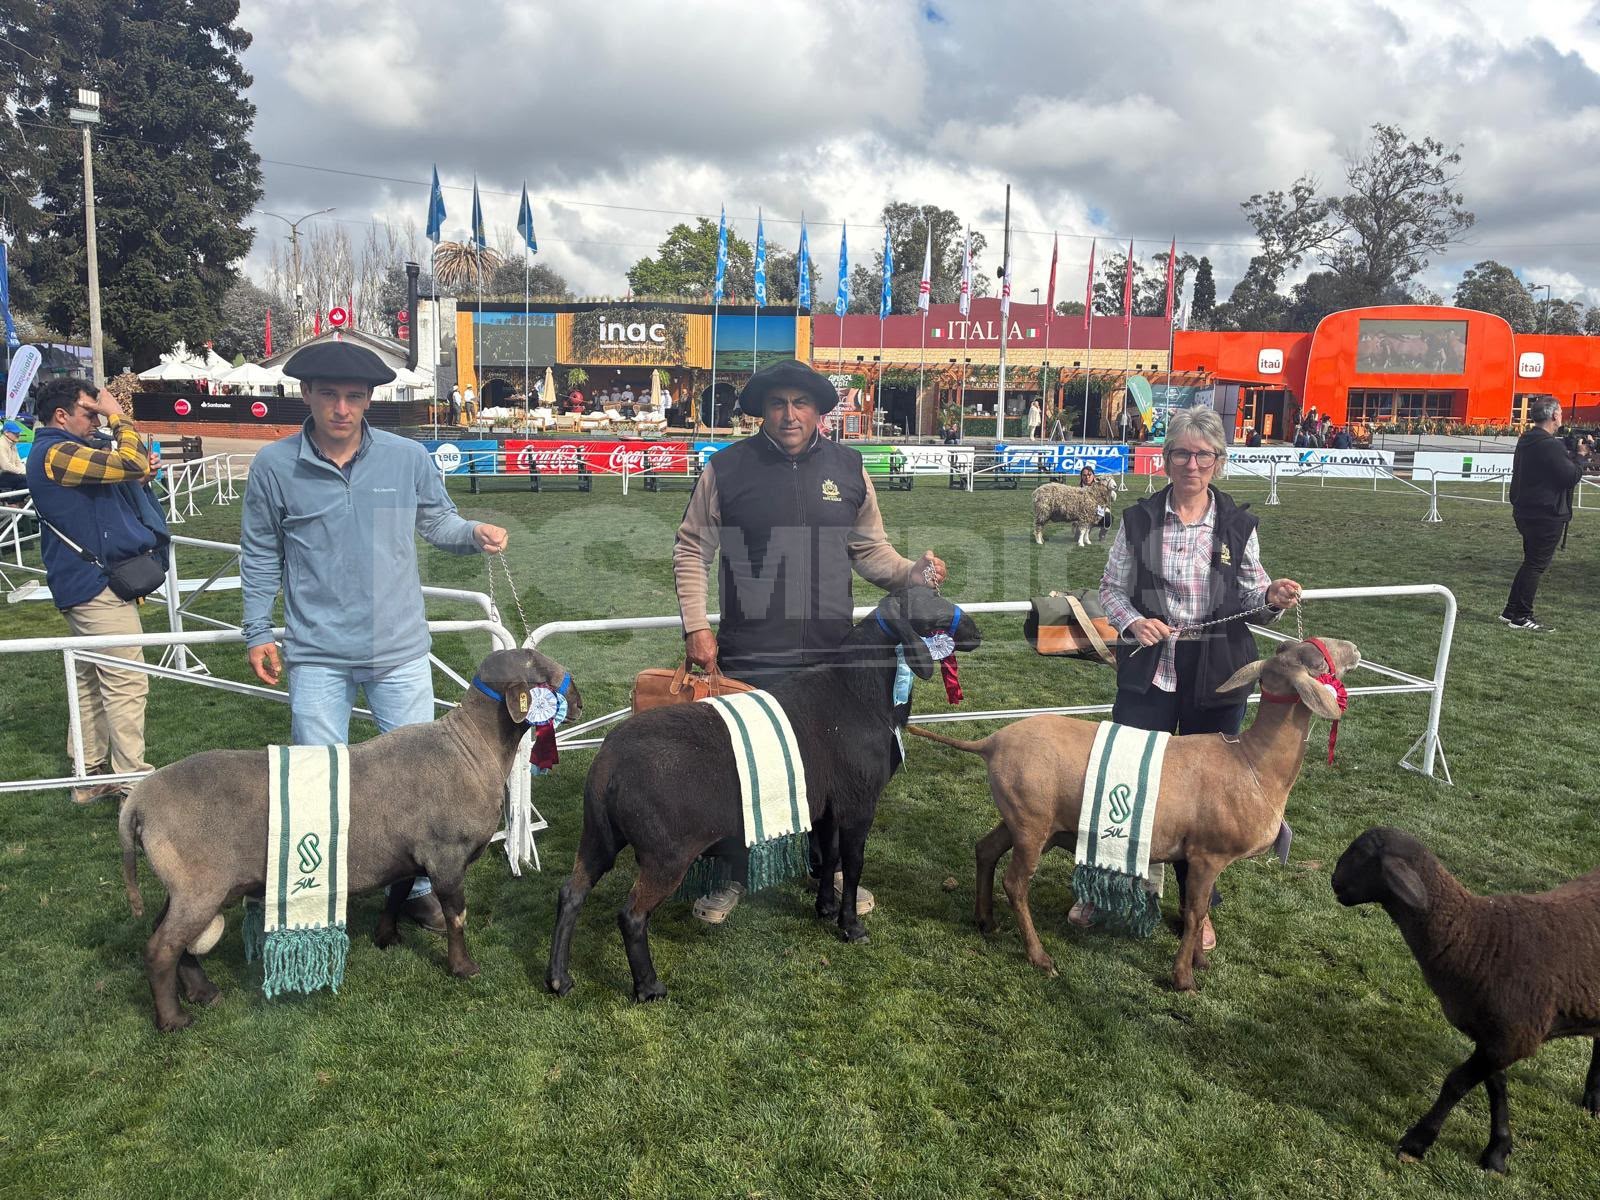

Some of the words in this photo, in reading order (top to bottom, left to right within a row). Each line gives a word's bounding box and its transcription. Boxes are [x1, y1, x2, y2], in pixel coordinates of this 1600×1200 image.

[599, 315, 666, 342] inac
[948, 320, 1024, 341] ITALA
[1260, 358, 1281, 369] itaú
[1521, 362, 1541, 373] itaú
[1062, 446, 1120, 457] PUNTA
[1229, 453, 1291, 464] KILOWATT
[1321, 455, 1385, 465] KILOWATT
[1100, 825, 1129, 840] SUL
[291, 876, 322, 896] SUL
